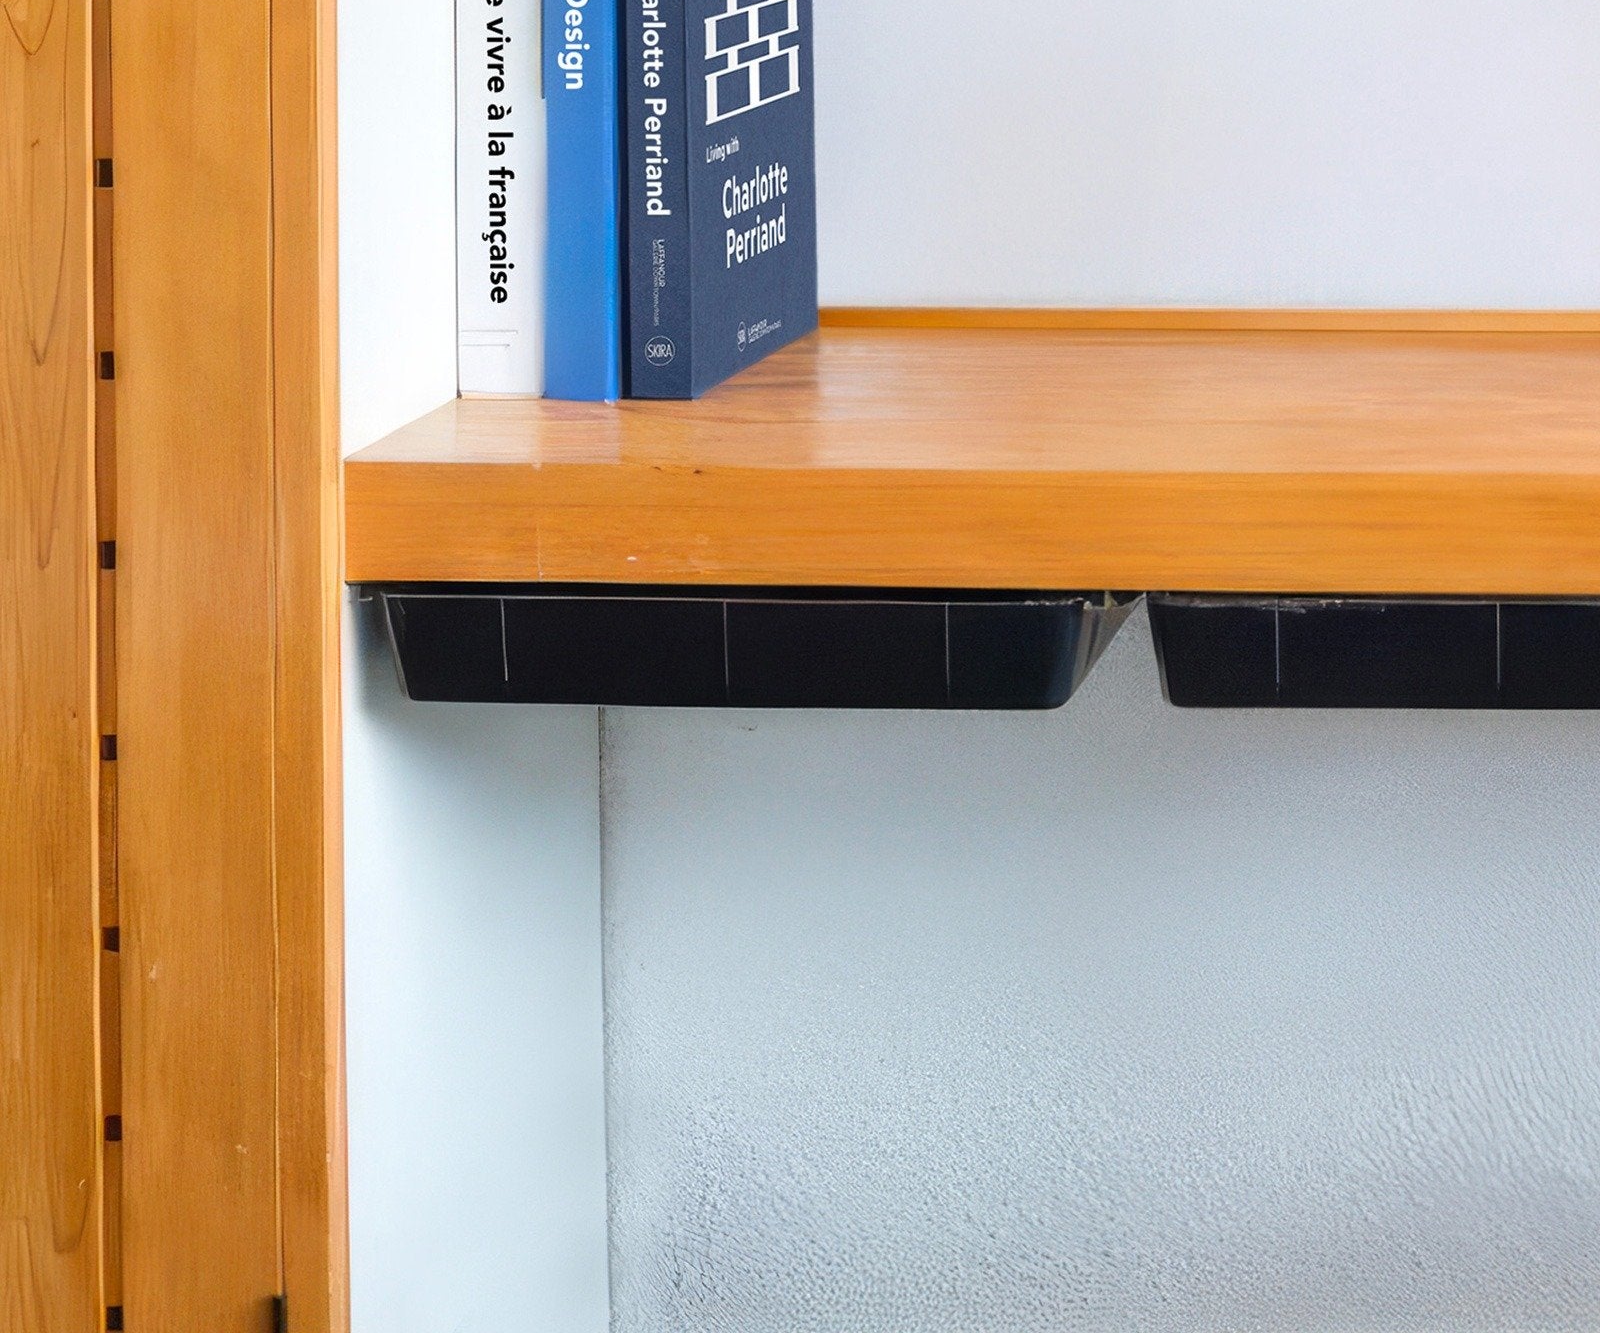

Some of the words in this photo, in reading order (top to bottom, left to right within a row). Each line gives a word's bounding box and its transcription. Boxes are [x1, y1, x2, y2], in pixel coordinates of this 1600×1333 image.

[487, 17, 511, 92] vivre
[488, 103, 511, 121] à
[488, 132, 513, 156] la
[644, 98, 671, 215] Perriand
[706, 143, 725, 164] Living
[725, 136, 740, 156] with
[722, 162, 788, 219] Charlotte
[482, 167, 514, 303] française
[726, 204, 786, 269] Perriand
[647, 341, 673, 359] SKIRA
